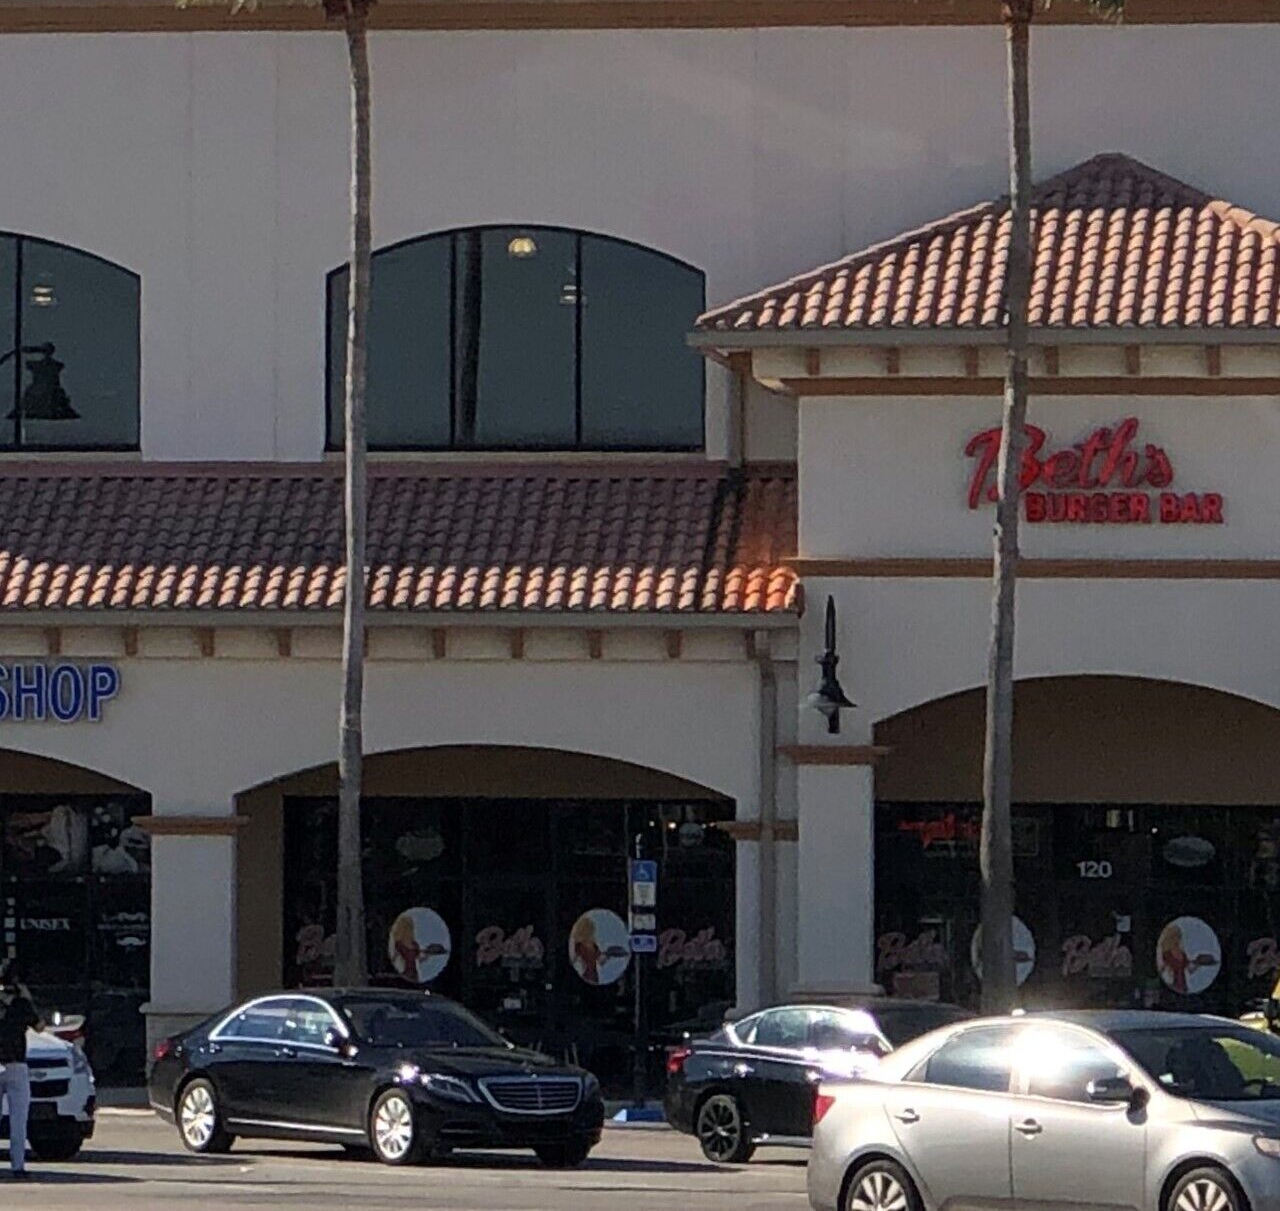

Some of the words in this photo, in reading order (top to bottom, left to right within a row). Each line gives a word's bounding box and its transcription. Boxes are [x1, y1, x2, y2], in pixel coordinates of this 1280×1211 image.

[1026, 492, 1150, 524] BURGER
[1159, 492, 1224, 524] BAR
[1077, 860, 1114, 878] 120
[19, 918, 71, 931] UNISEX
